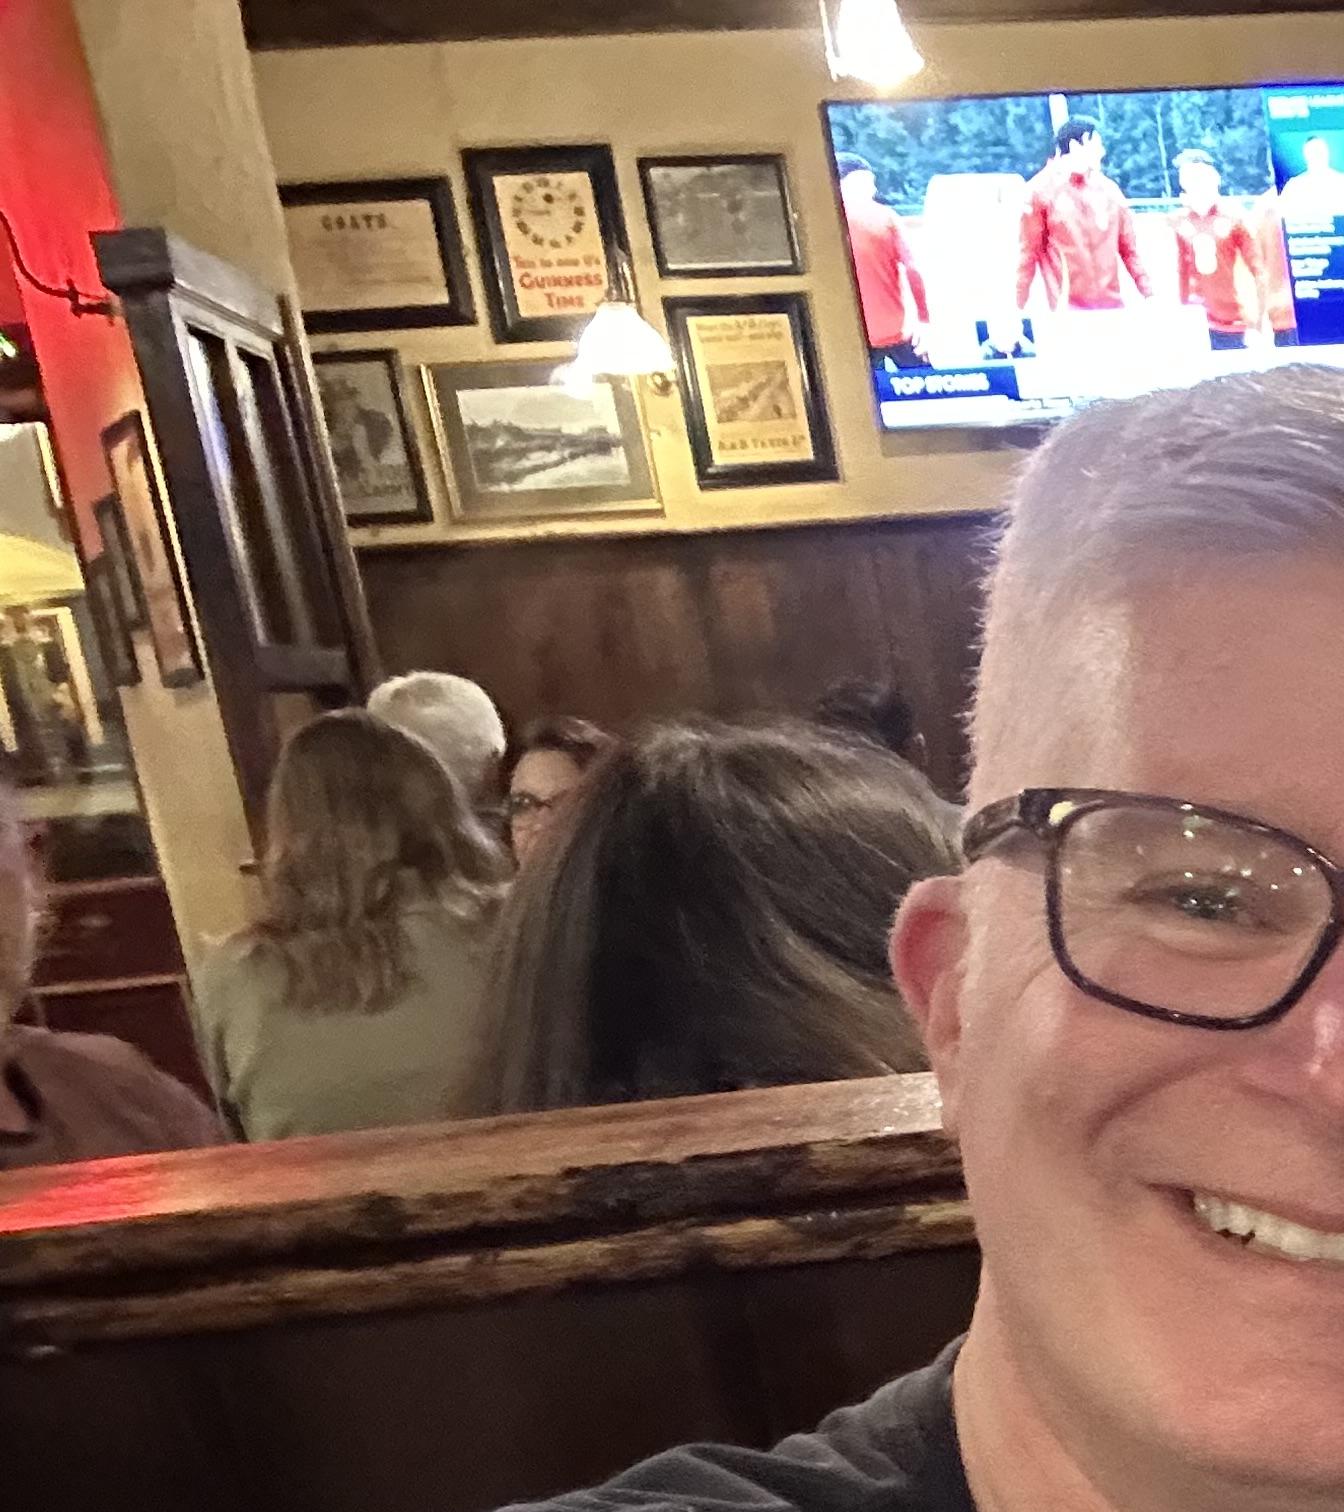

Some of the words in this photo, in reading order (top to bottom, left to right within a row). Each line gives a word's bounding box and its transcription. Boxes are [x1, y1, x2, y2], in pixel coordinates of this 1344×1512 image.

[519, 272, 602, 289] GUINNESS
[545, 293, 585, 308] TIME
[890, 376, 924, 395] TOP
[925, 373, 990, 394] STORIES
